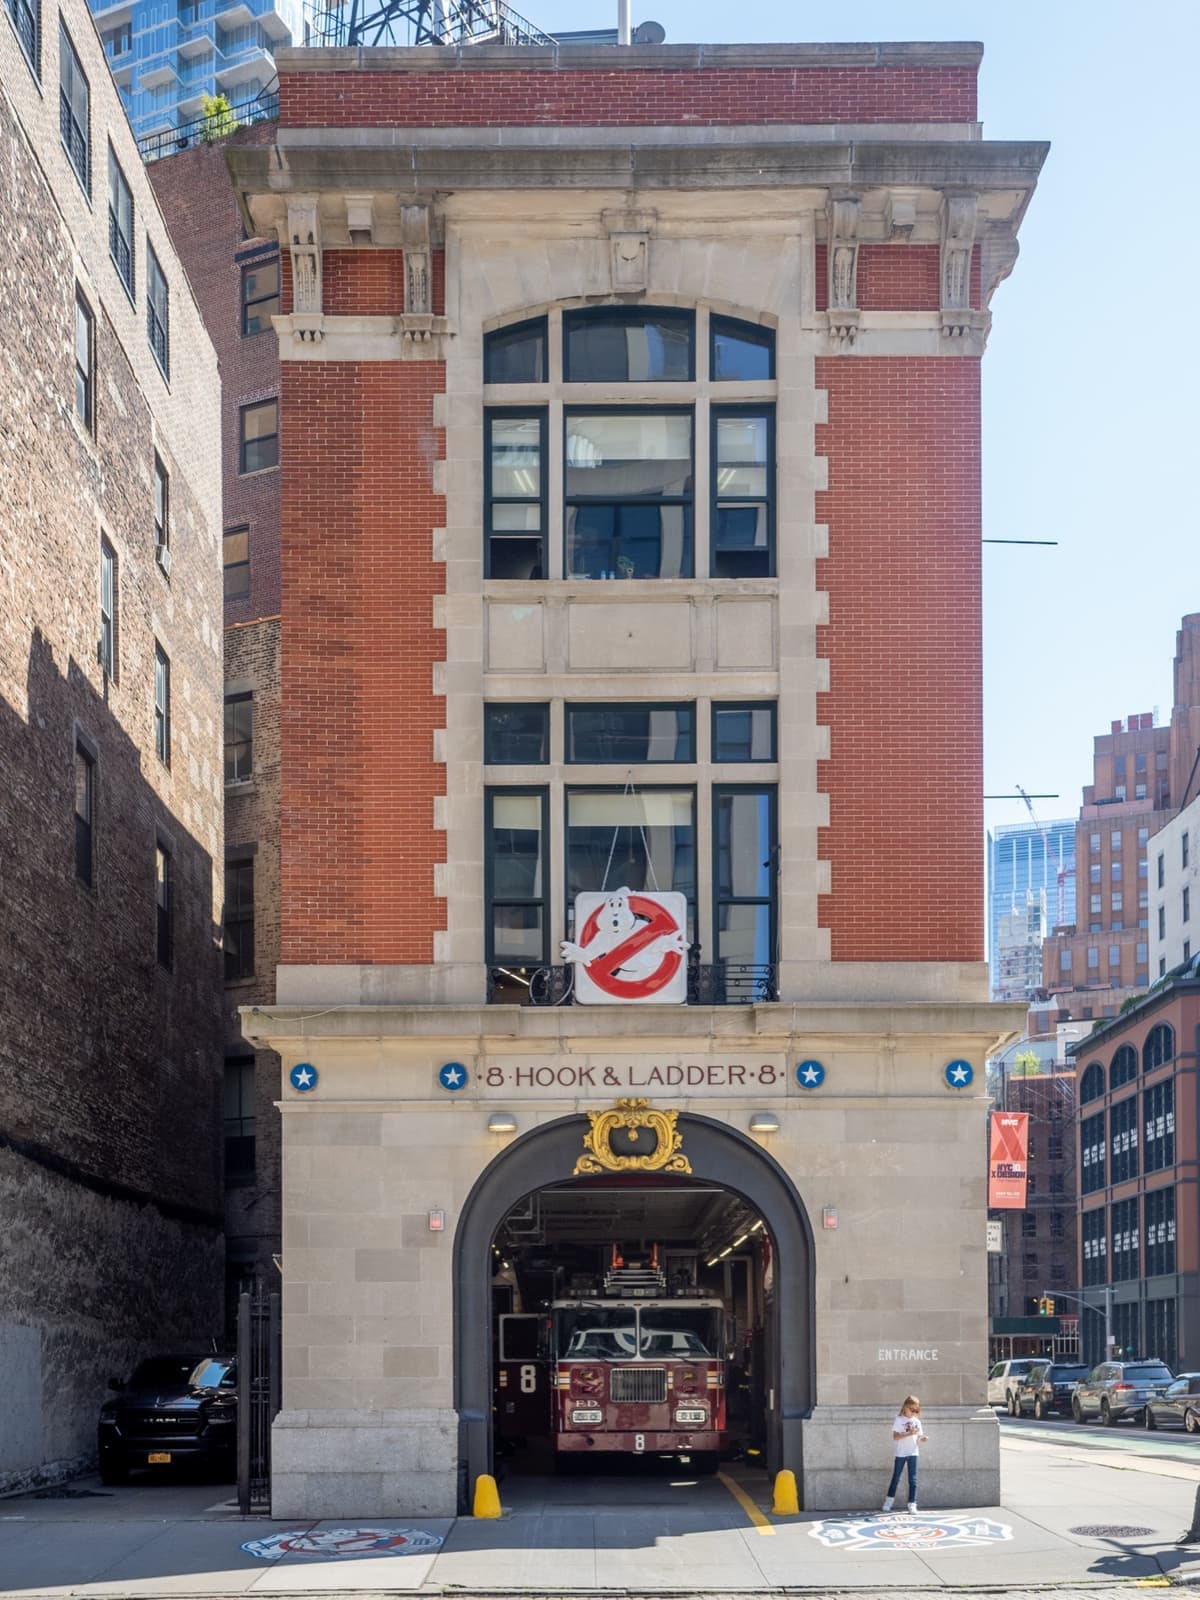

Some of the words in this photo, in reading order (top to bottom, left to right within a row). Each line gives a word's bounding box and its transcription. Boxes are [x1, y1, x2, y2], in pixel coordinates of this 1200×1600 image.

[515, 1066, 597, 1087] HOOK
[602, 1066, 622, 1087] &
[628, 1065, 746, 1086] LADDER
[878, 1348, 939, 1361] ENTRANCE
[520, 1364, 537, 1393] 8
[634, 1433, 646, 1451] 8
